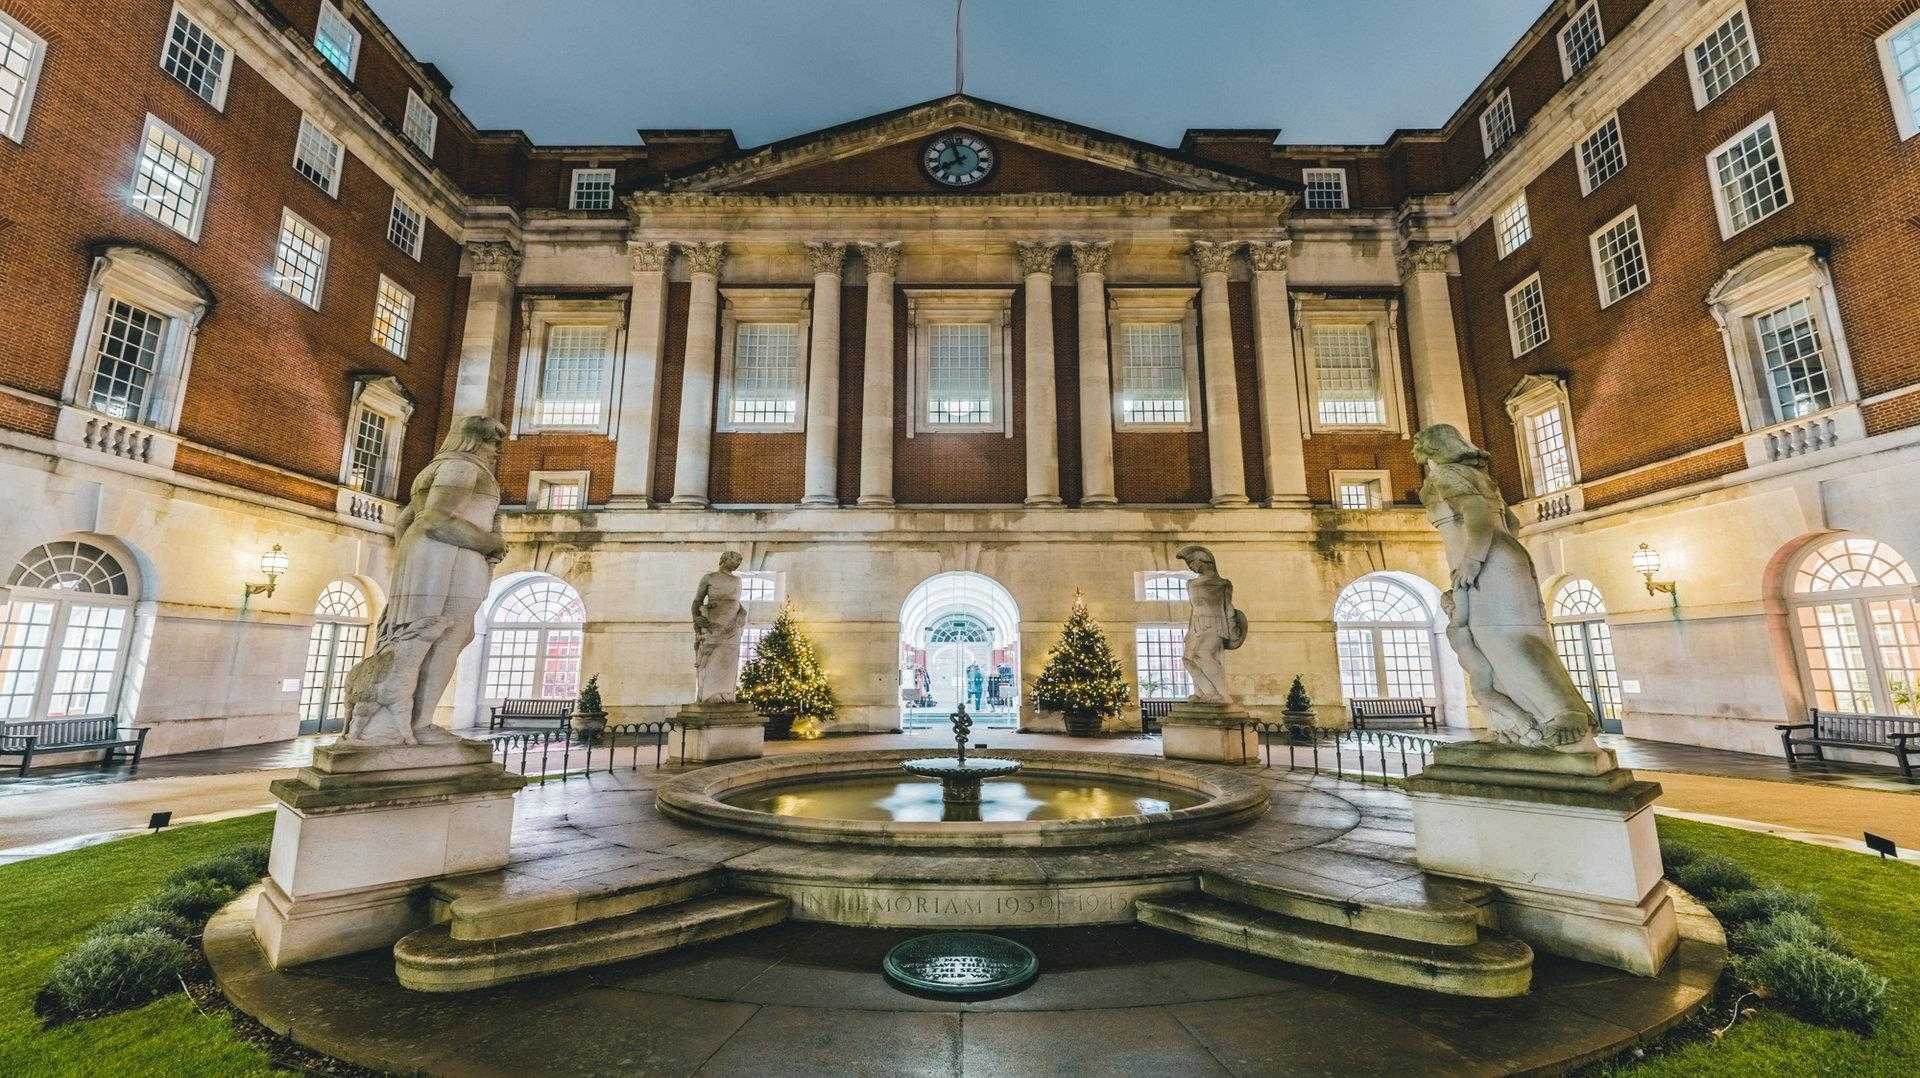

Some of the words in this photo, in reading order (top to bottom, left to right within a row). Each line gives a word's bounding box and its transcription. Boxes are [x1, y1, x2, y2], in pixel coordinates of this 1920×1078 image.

[800, 891, 825, 914] IN
[833, 894, 982, 915] MEMORIAM
[996, 896, 1054, 915] 1939
